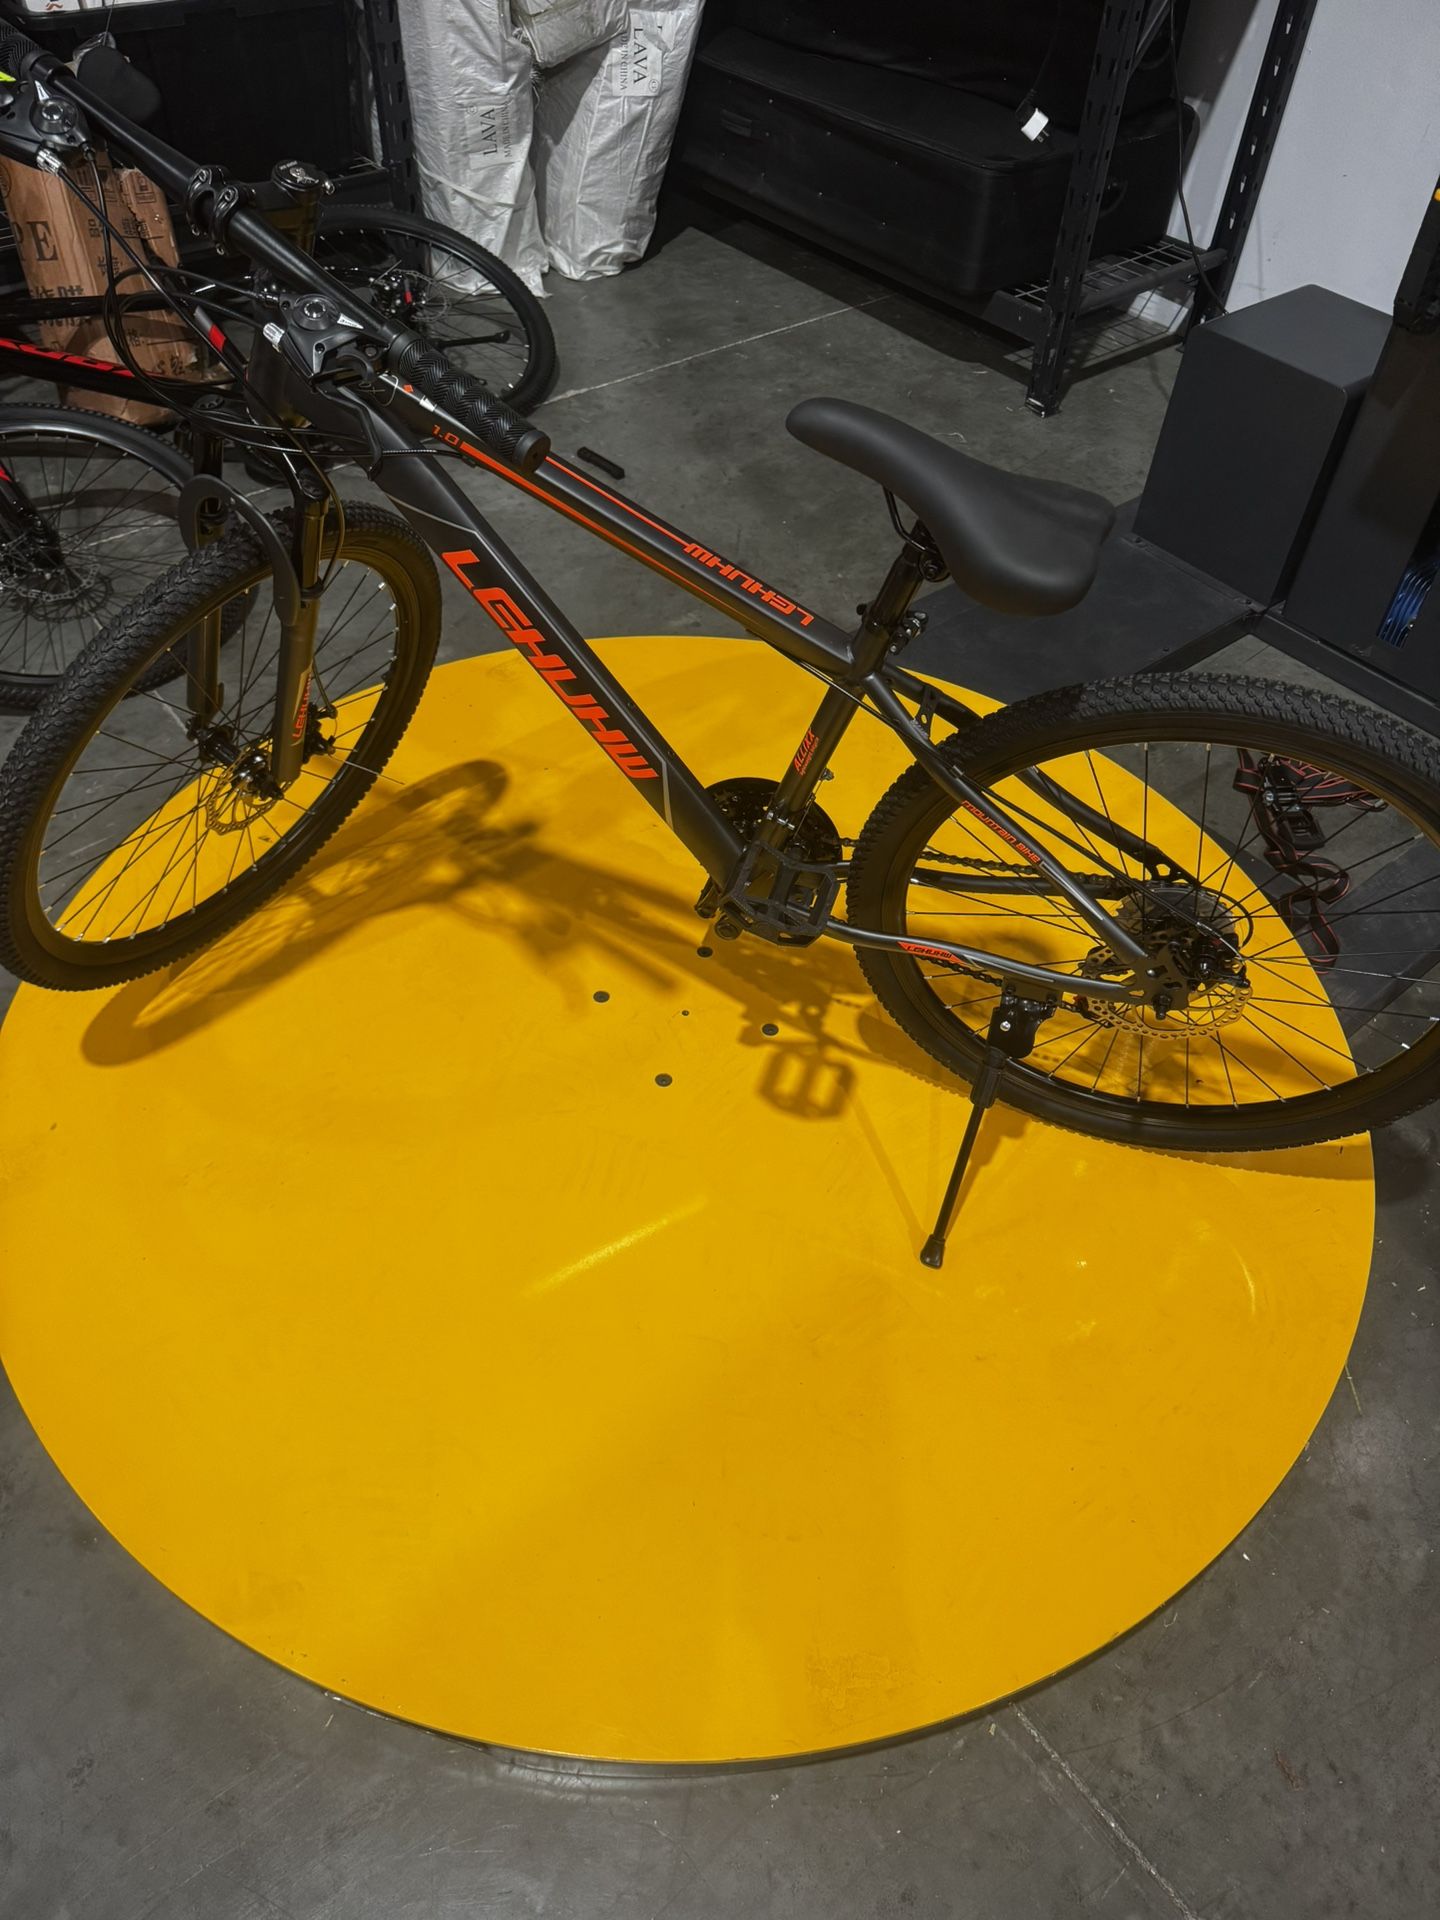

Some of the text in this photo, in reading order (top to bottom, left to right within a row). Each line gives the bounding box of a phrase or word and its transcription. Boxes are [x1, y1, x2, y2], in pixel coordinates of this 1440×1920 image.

[632, 27, 648, 84] LAVA
[480, 108, 498, 155] LAVA
[432, 424, 460, 447] 1.0
[440, 549, 660, 779] LEHUHW
